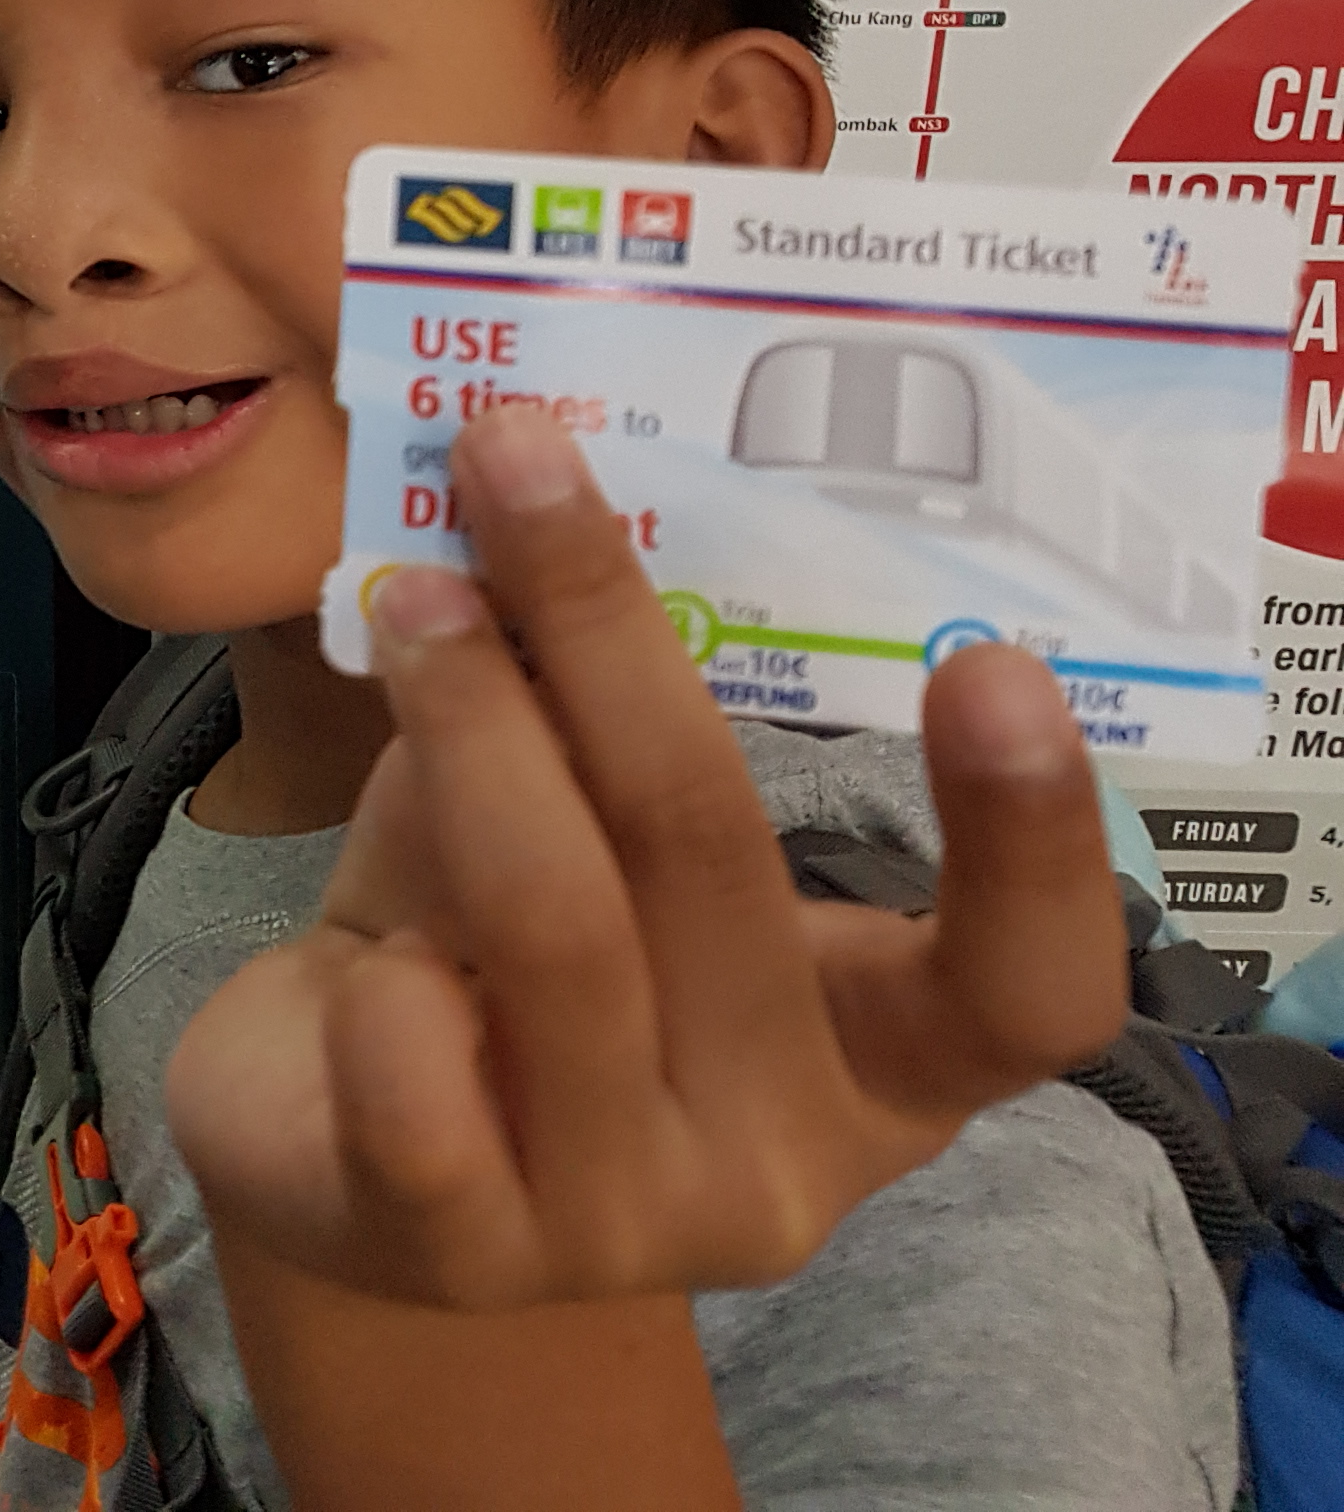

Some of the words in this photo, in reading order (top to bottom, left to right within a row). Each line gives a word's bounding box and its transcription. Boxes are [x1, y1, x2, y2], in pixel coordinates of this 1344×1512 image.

[827, 10, 862, 26] Chu
[867, 10, 913, 29] Kang
[930, 12, 957, 25] NS4
[835, 117, 898, 133] ombak
[915, 118, 943, 132] NS3
[734, 217, 943, 267] Standard
[961, 230, 1099, 278] Ticket
[1292, 279, 1338, 352] A
[411, 314, 519, 367] USE
[407, 375, 439, 419] 6
[624, 408, 663, 438] to
[1264, 595, 1344, 626] from
[1294, 687, 1344, 716] fol
[1171, 820, 1258, 843] FRIDAY
[1308, 885, 1334, 906] 5,
